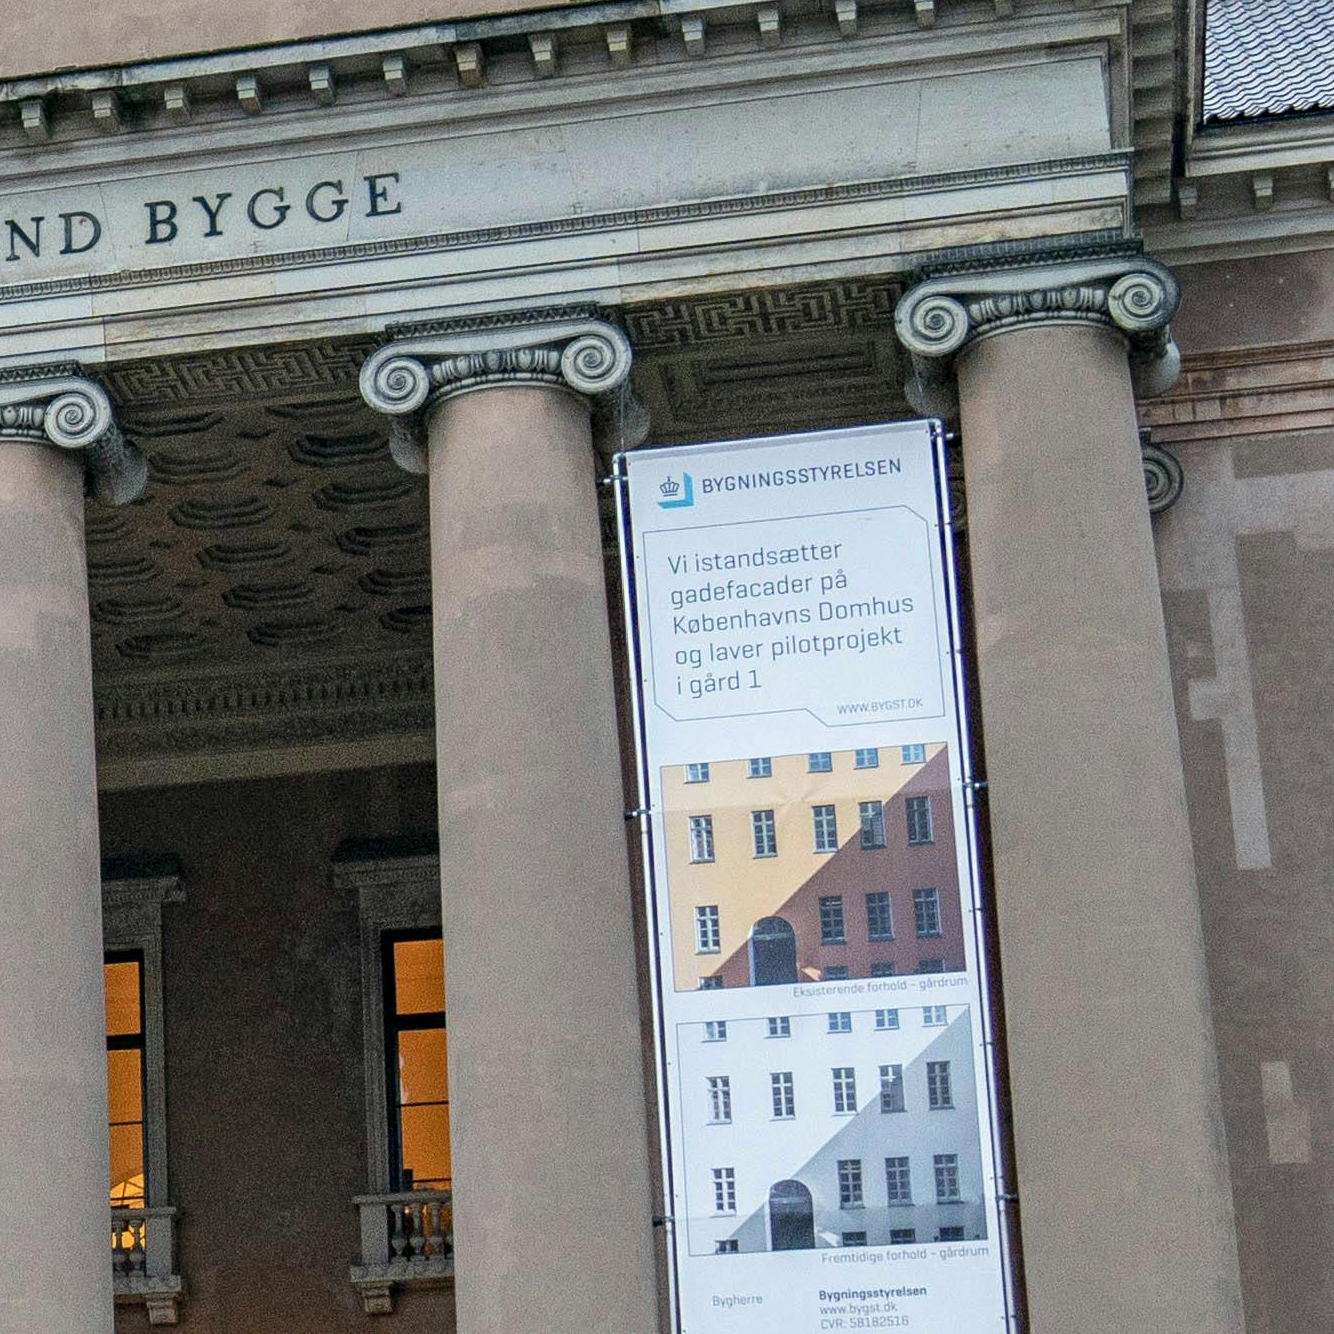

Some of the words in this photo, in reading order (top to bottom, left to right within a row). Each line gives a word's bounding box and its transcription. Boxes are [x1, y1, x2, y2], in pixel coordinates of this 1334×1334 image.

[145, 171, 405, 244] BYGGE
[702, 458, 902, 494] BYGNINGSSTYRELSEN
[668, 555, 688, 574] Vi
[695, 541, 843, 573] istandsætter
[671, 574, 813, 609] gadefacader
[821, 569, 848, 595] på
[673, 609, 811, 635] Københavns
[819, 596, 914, 622] Domhus
[675, 649, 702, 668] og
[709, 641, 763, 662] laver
[771, 626, 903, 661] pilotprojekt
[677, 678, 683, 695] i
[690, 671, 740, 699] gård
[749, 670, 762, 689] 1
[837, 698, 923, 714] WWW.BYGST.DK
[793, 983, 864, 997] Eksisterende
[867, 980, 907, 992] forhold
[920, 976, 967, 991] gårdrum
[822, 1250, 883, 1264] Fremtidige
[887, 1249, 927, 1260] forhold
[940, 1246, 989, 1260] gårdrum
[712, 1294, 763, 1307] Bygherre
[819, 1286, 927, 1302] Bygningsstyrelsen
[820, 1301, 898, 1316] www.bygst.dk
[821, 1319, 845, 1330] CVR:
